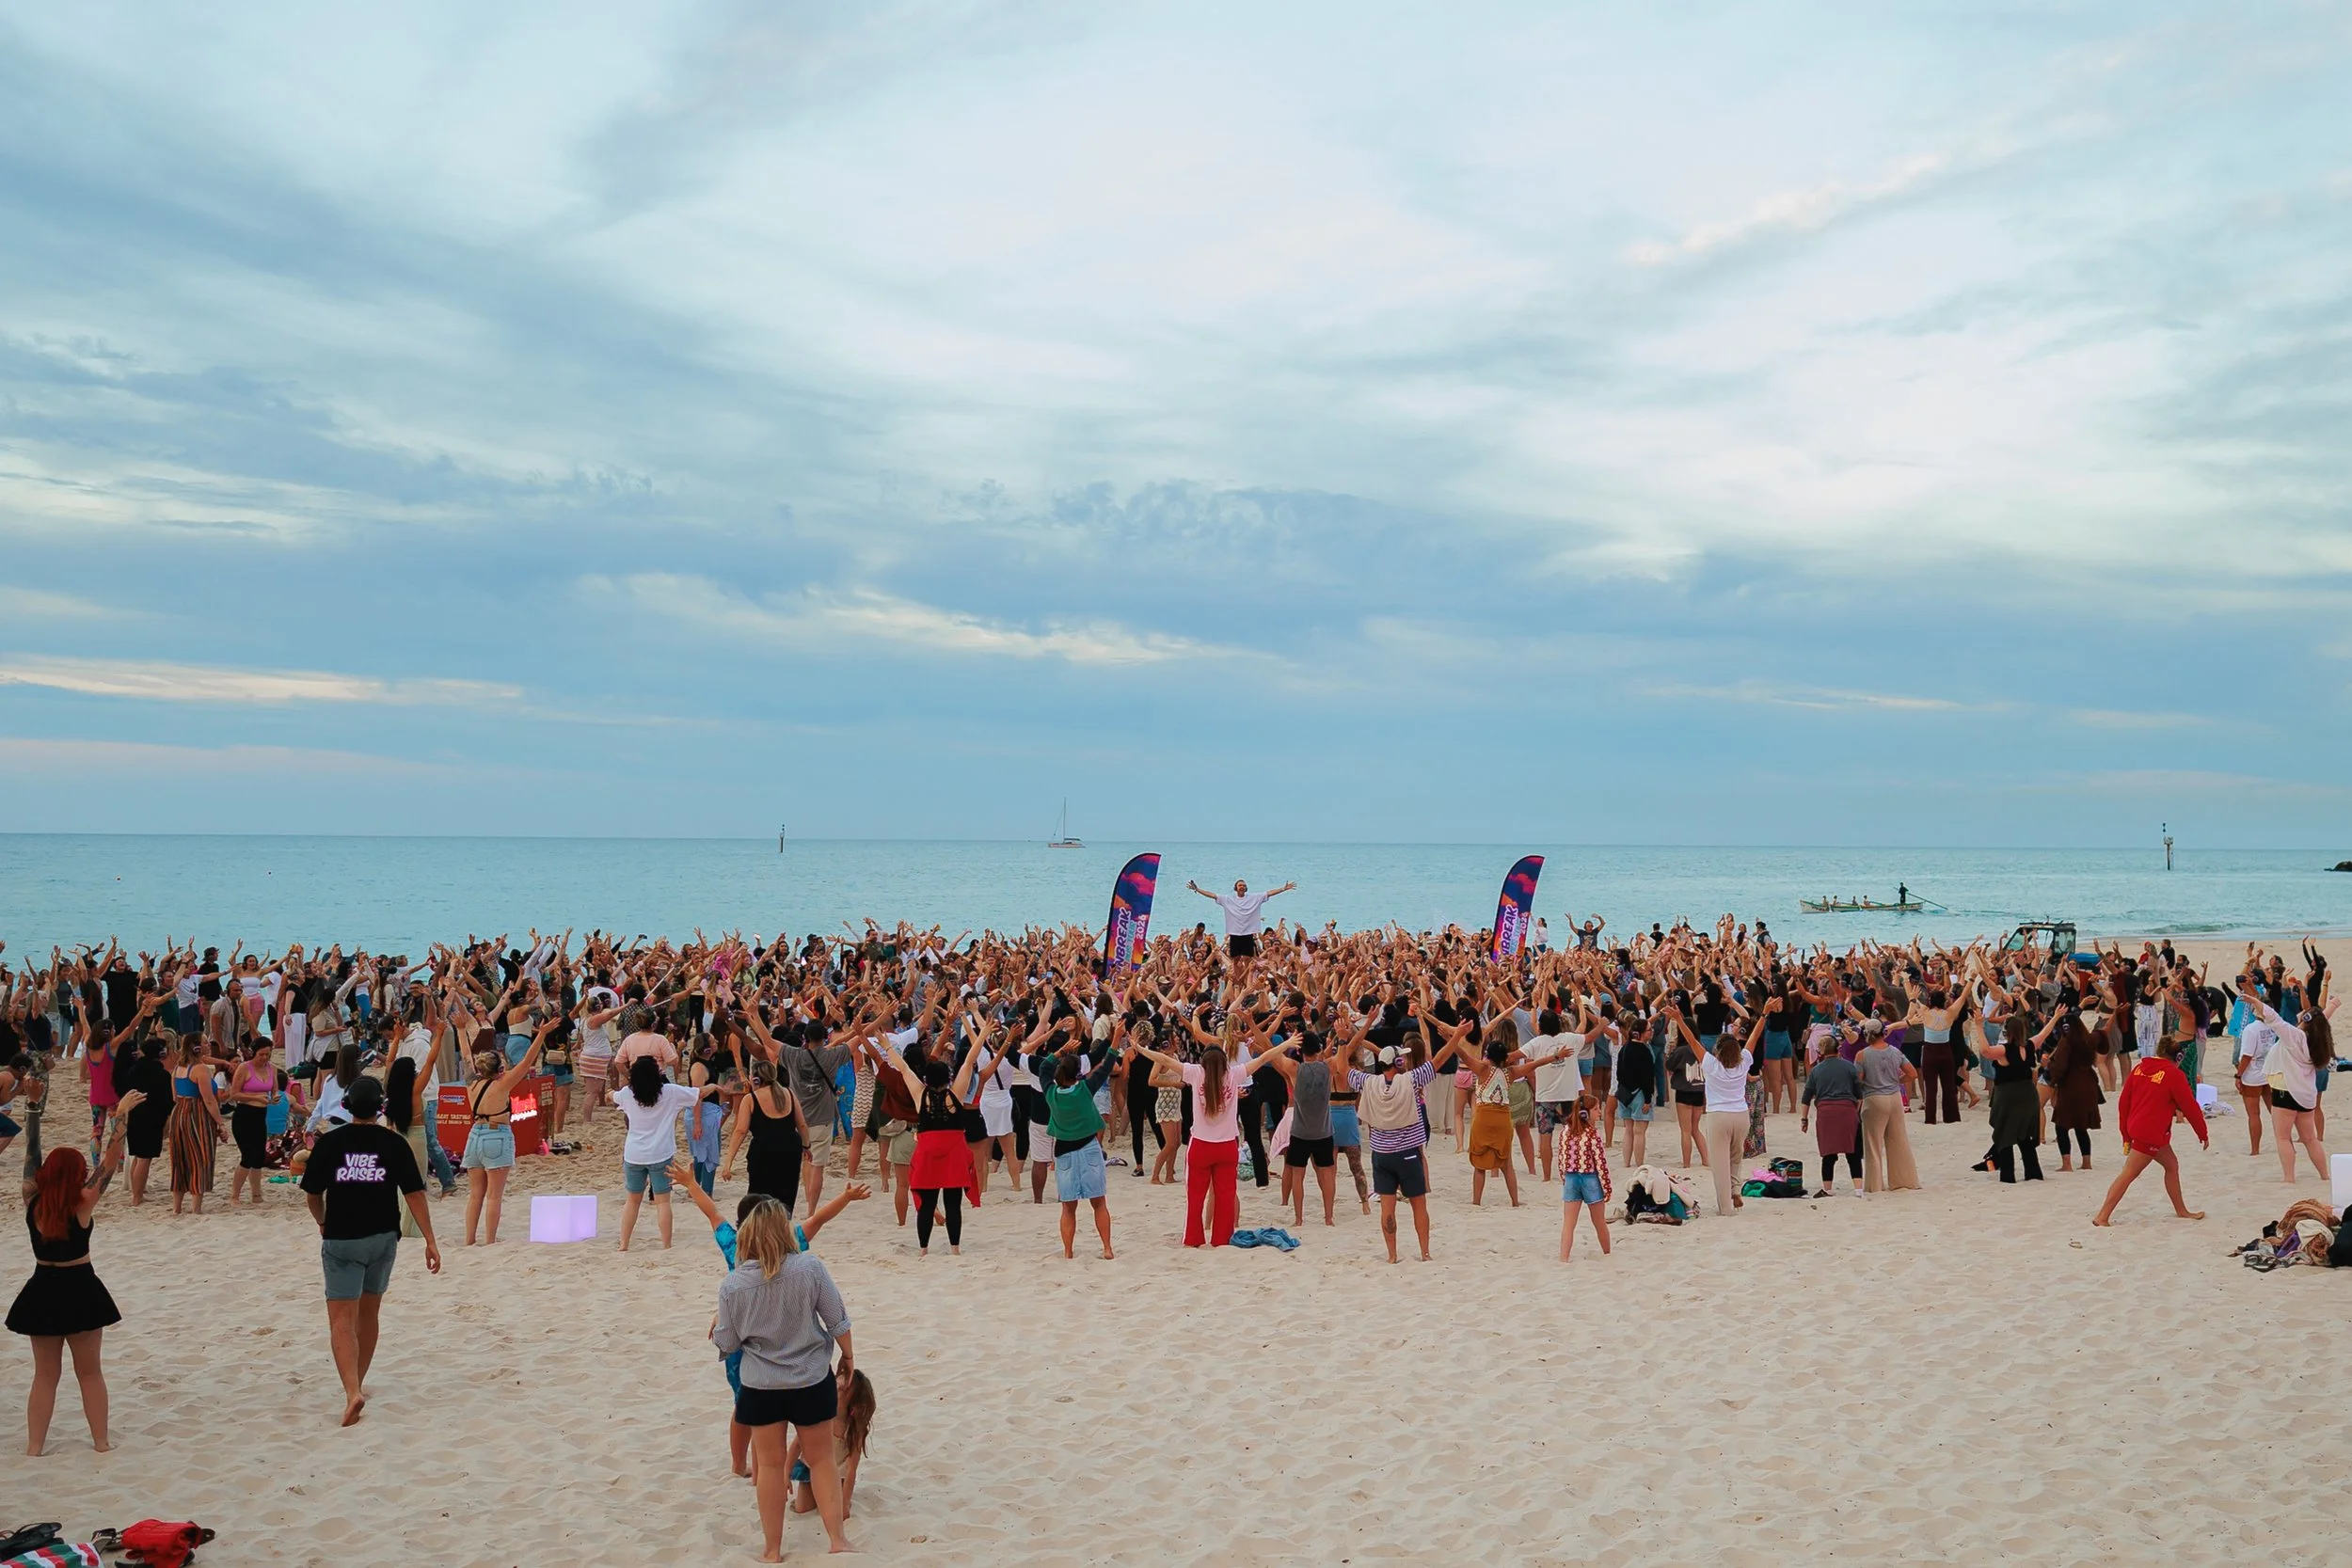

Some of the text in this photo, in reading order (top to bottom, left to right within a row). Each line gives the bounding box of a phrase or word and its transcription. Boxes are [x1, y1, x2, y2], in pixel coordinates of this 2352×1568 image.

[1136, 914, 1147, 940] 2026
[345, 1153, 378, 1167] VIBE
[336, 1167, 386, 1181] RAISER
